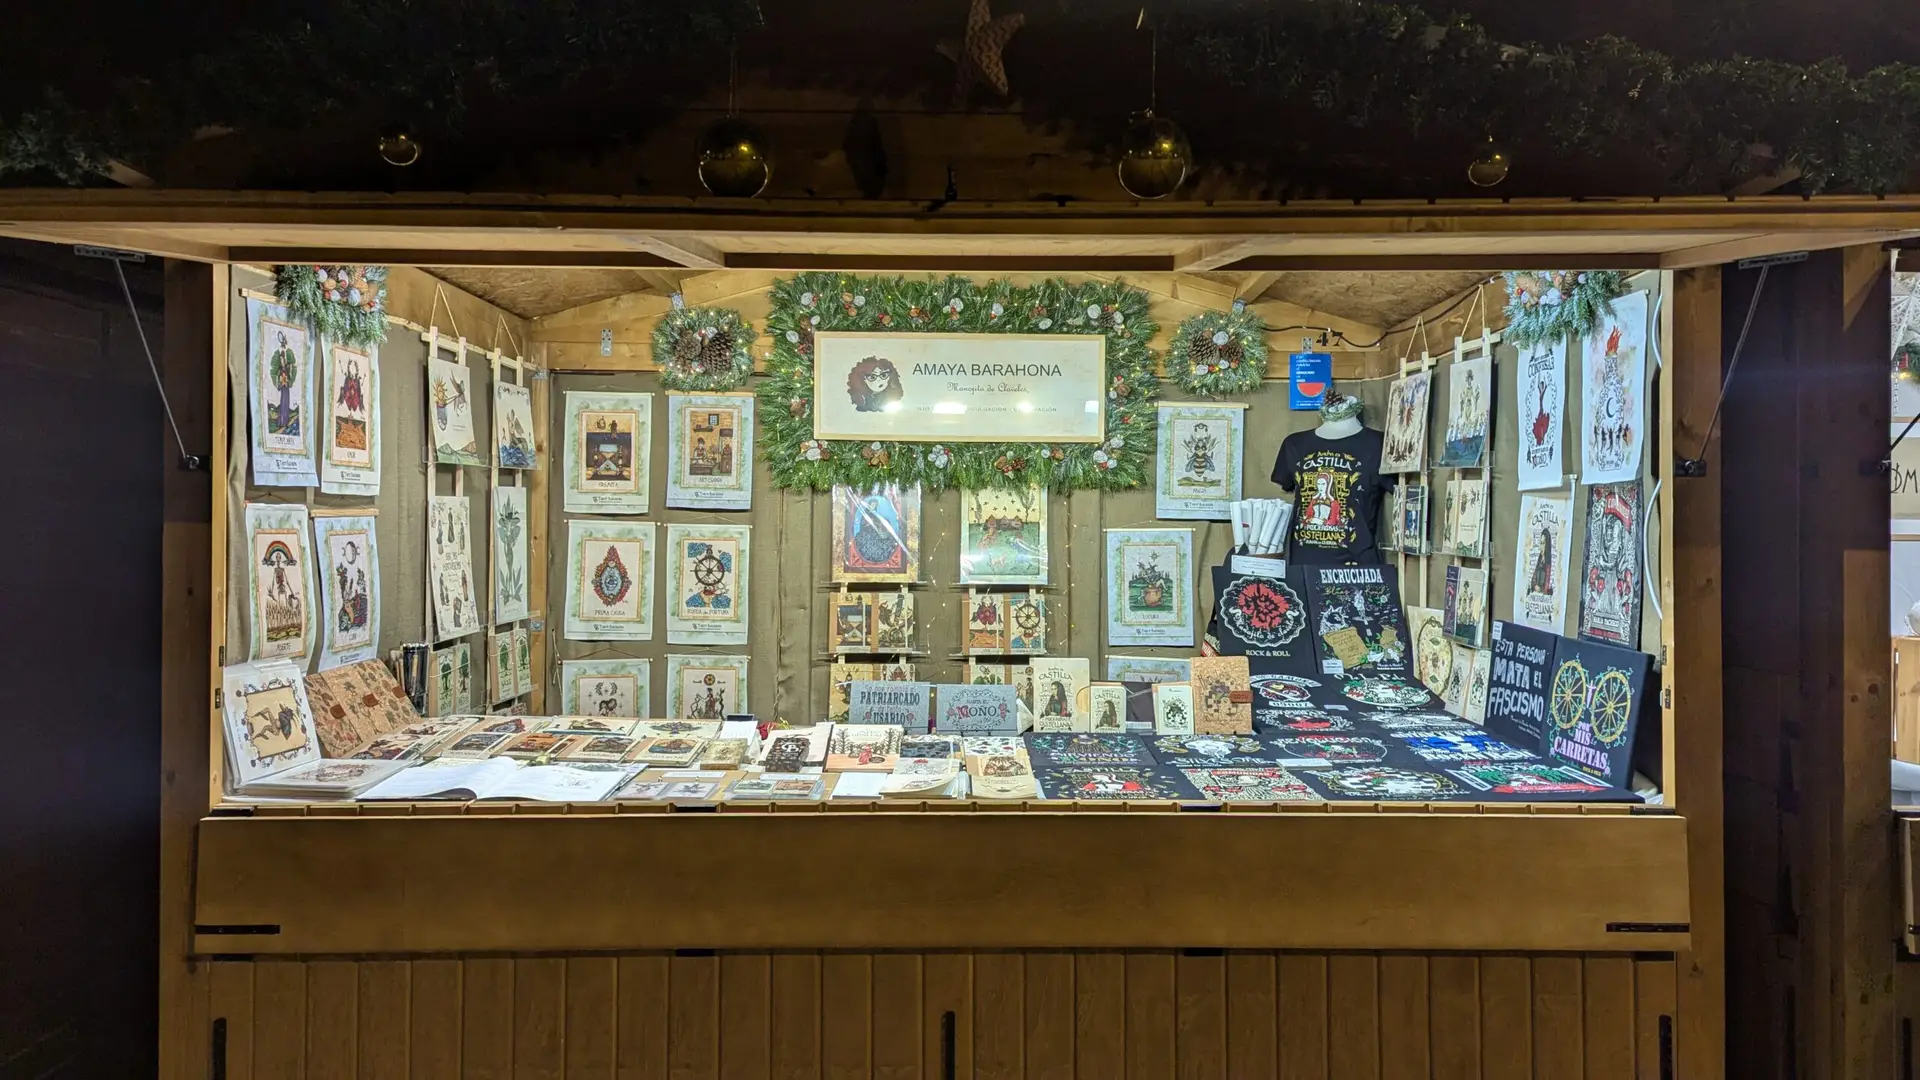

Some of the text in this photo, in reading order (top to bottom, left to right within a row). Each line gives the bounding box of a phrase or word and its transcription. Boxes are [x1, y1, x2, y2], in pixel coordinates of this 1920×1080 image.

[912, 363, 1062, 377] AMAYA BARAHONA
[946, 382, 985, 395] Manojito
[985, 383, 995, 392] de
[1303, 456, 1352, 471] CASTILLA
[1531, 510, 1560, 527] CASTILLA
[1319, 568, 1384, 585] ENCRUCIJADA
[1246, 649, 1265, 657] ROCK
[1495, 639, 1546, 665] ESTA PERSONA
[1038, 671, 1073, 681] CASTILLA
[1493, 656, 1543, 690] MATA EL
[860, 691, 920, 706] PATRIARCADO
[1487, 687, 1544, 722] FASCISMO
[1576, 720, 1592, 732] POR
[1573, 728, 1592, 746] MIS
[1554, 735, 1609, 770] CARRETAS
